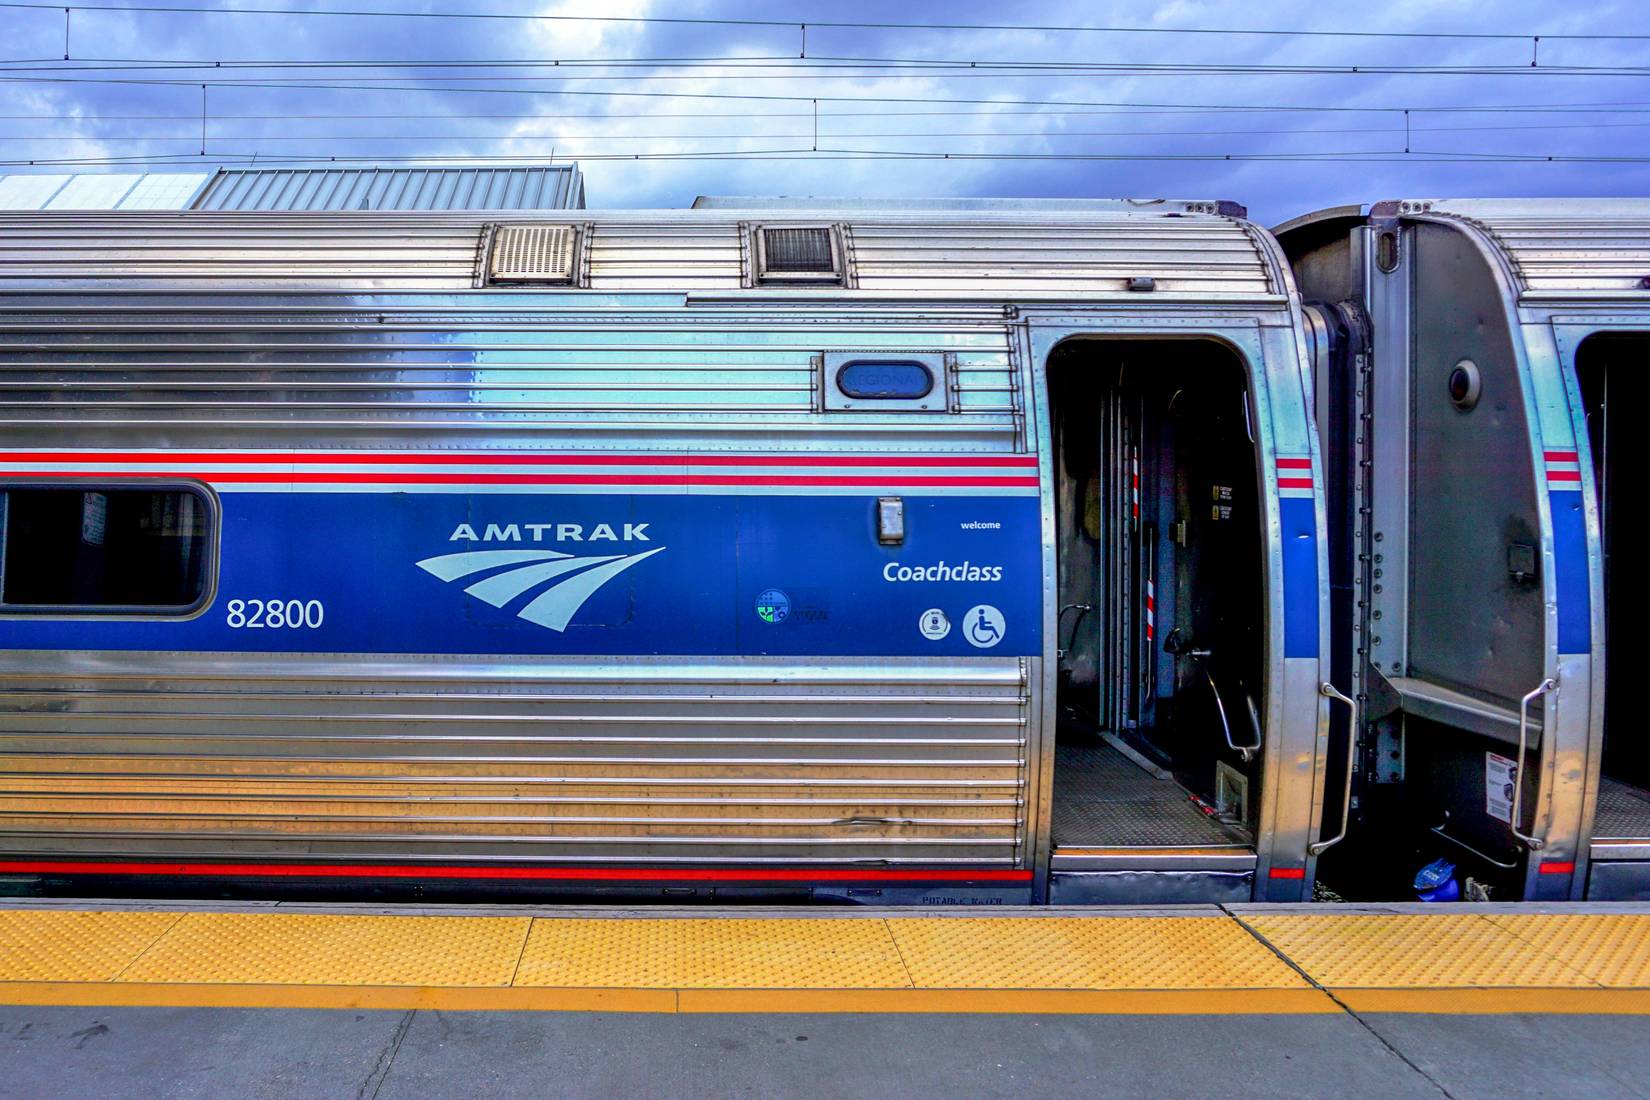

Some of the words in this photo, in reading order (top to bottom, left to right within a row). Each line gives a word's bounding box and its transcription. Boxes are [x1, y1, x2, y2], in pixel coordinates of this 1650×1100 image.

[450, 524, 649, 540] AMTRAK
[884, 561, 1002, 581] Coachclass
[227, 600, 323, 628] 82800
